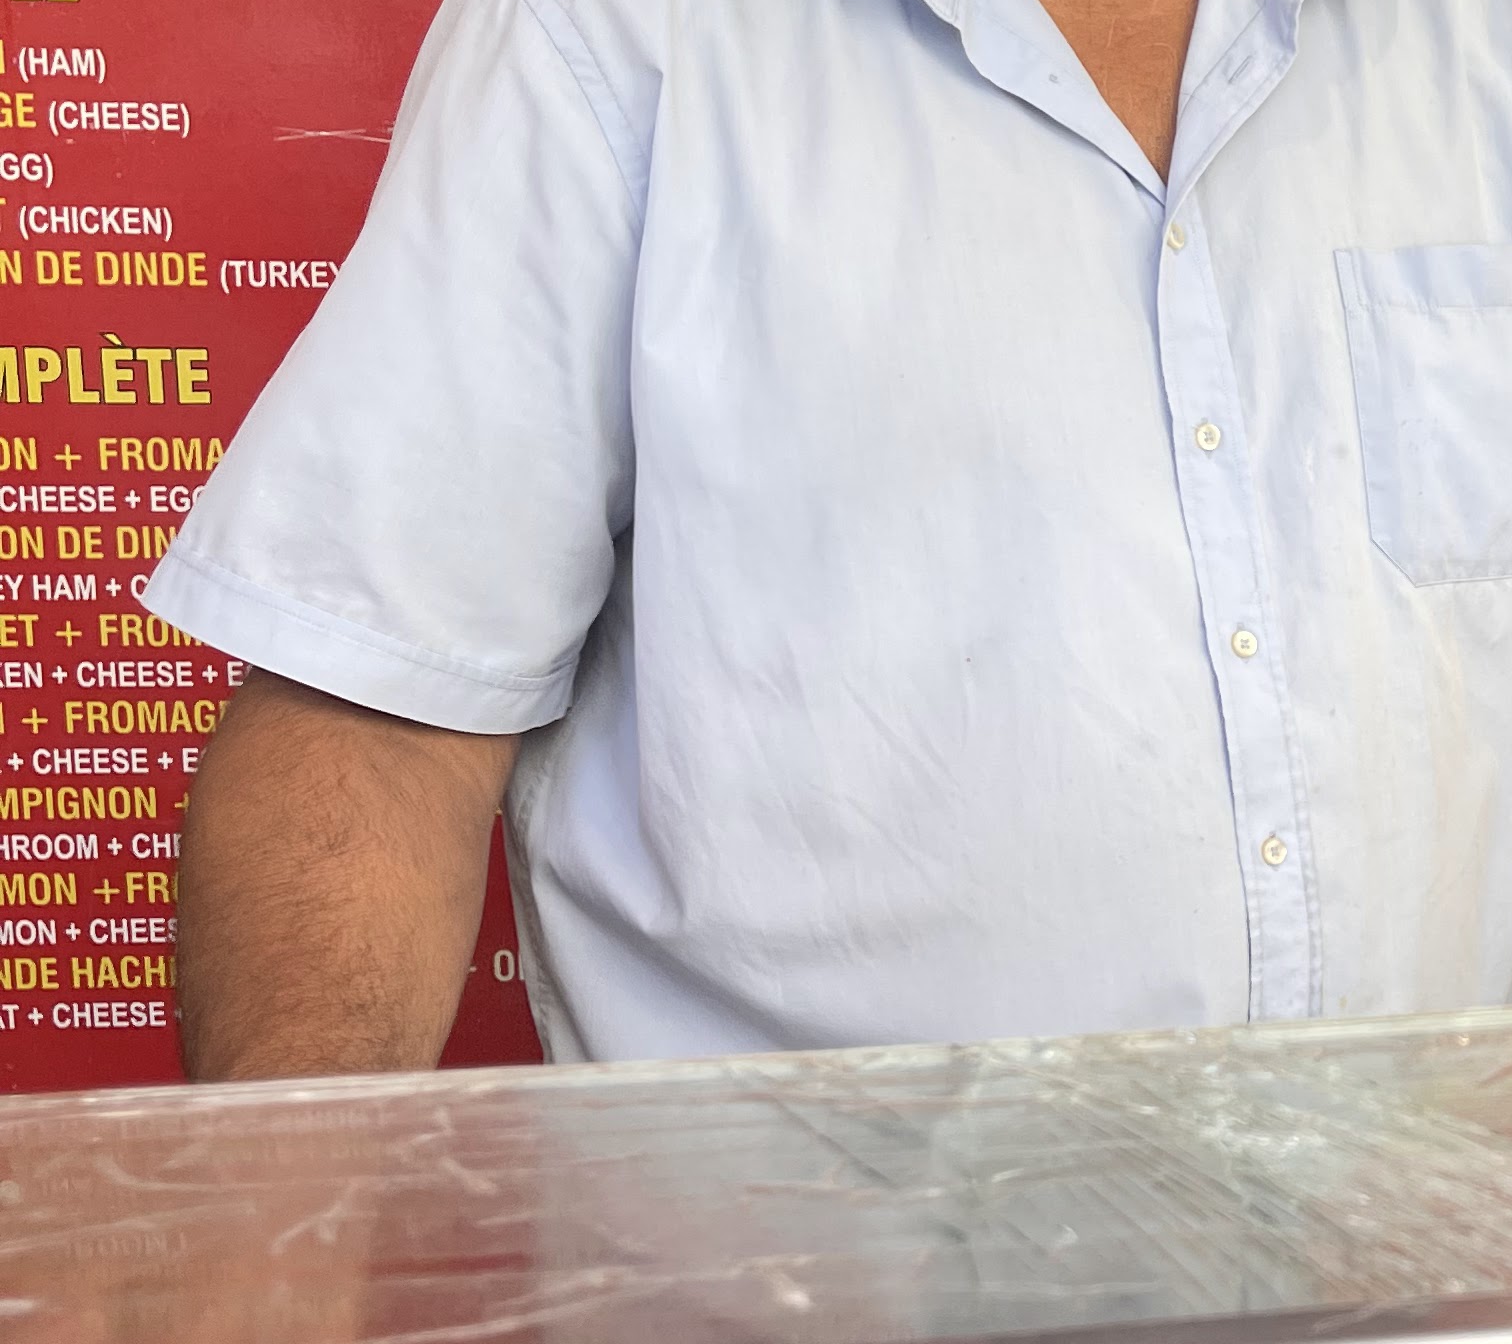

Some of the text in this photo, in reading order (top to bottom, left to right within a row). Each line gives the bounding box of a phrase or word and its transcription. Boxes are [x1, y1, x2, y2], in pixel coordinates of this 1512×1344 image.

[18, 47, 106, 84] (HAM)
[48, 100, 190, 138] (CHEESE)
[19, 205, 173, 242] (CHICKEN)
[35, 250, 83, 286] DE
[94, 251, 208, 287] DINDE
[0, 331, 213, 406] MPLÈTE
[98, 436, 226, 472] FROMA
[0, 485, 117, 513] CHEESE
[57, 525, 105, 559] DE
[32, 574, 97, 601] HAM
[76, 660, 194, 688] CHEESE
[32, 747, 150, 775] CHEESE
[0, 786, 157, 820] MPIGNON
[52, 1001, 167, 1029] CHEESE
